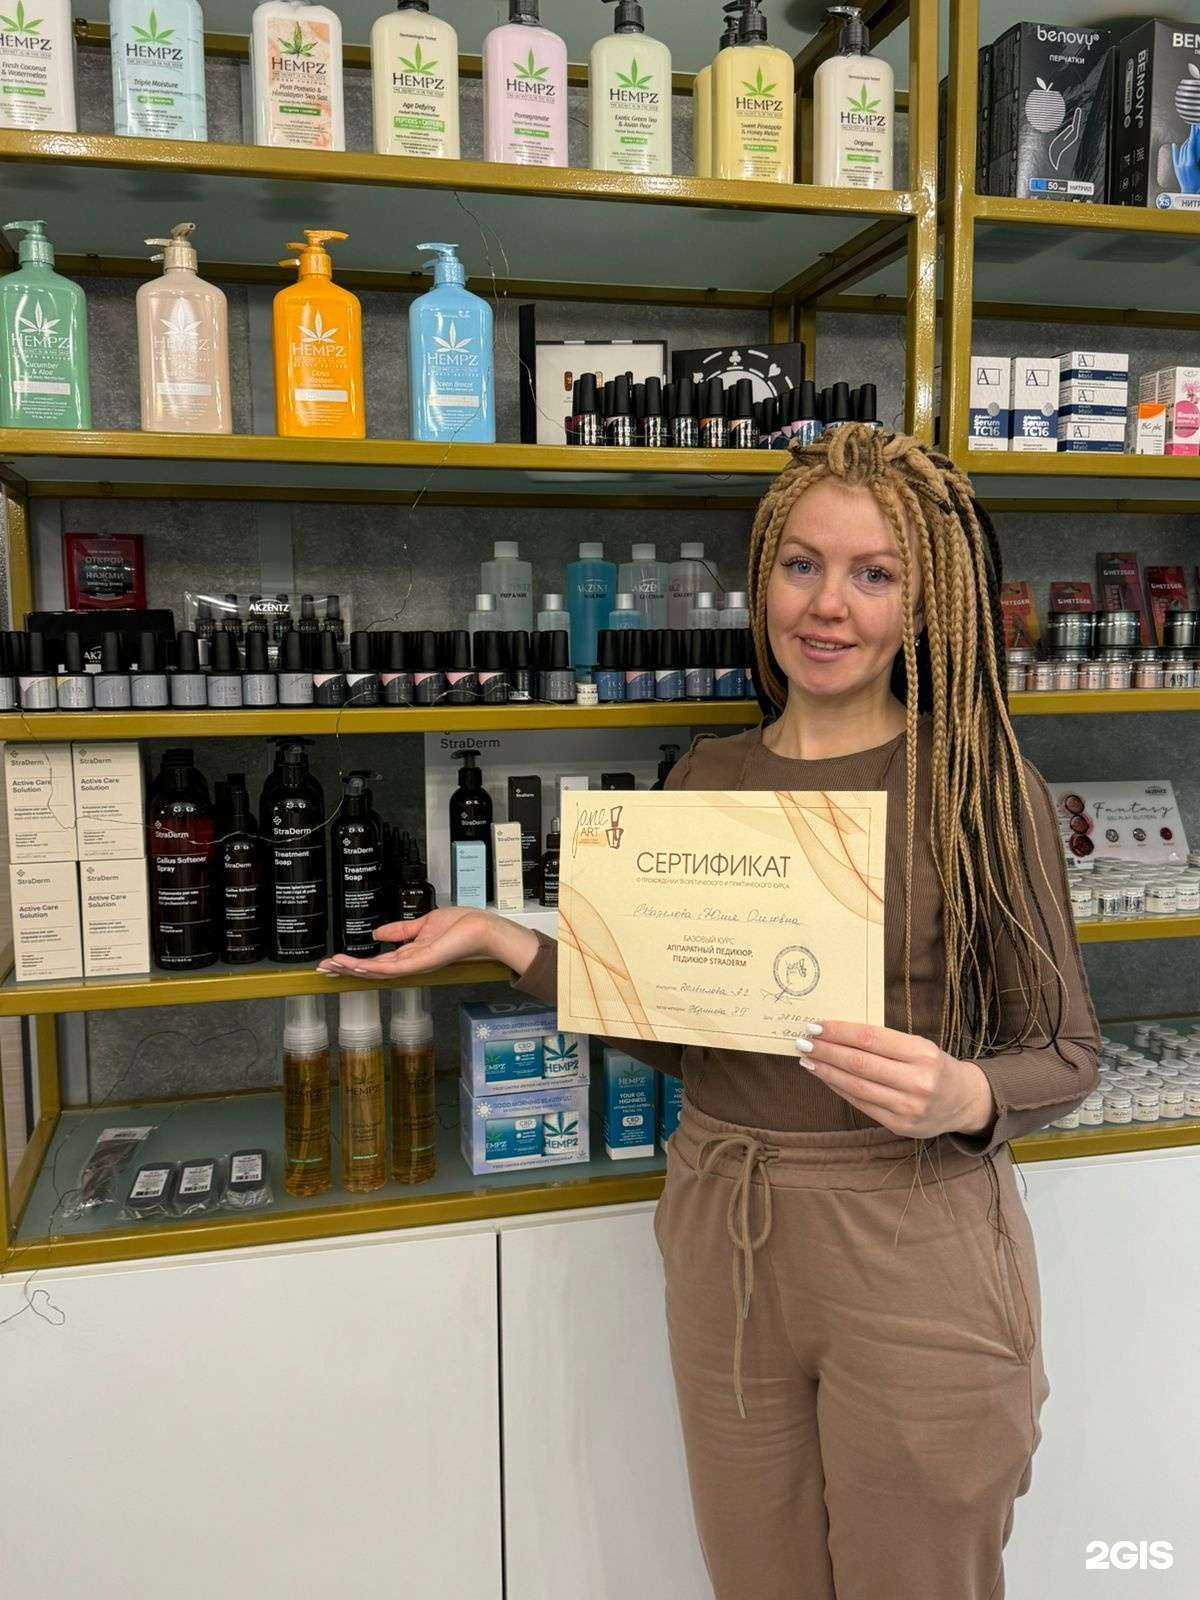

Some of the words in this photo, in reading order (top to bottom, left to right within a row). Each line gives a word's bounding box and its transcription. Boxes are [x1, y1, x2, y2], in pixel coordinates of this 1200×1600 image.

[126, 43, 183, 61] HEMPZ
[20, 64, 47, 72] Coconut
[271, 57, 327, 75] HEMPZ
[8, 69, 48, 79] Watermelon
[393, 73, 445, 90] HEMPZ
[506, 79, 556, 97] HEMPZ
[609, 88, 659, 104] HEMPZ
[402, 102, 414, 110] Age
[415, 103, 437, 112] Defying
[736, 97, 784, 112] HEMPZ
[840, 112, 886, 128] HEMPZ
[11, 333, 72, 349] HEMPZ
[292, 342, 346, 358] HEMPZ
[427, 352, 479, 366] HEMPZ
[974, 418, 1001, 427] Serum
[1023, 419, 1050, 428] Serum
[973, 426, 1001, 437] TC16
[1022, 426, 1050, 438] TC16
[441, 737, 500, 750] StraDerm
[11, 759, 45, 767] StraDerm
[80, 757, 112, 765] StraDerm
[13, 779, 34, 787] Active
[81, 778, 102, 786] Active
[13, 786, 42, 794] Solution
[1093, 802, 1174, 819] Fantasy
[155, 831, 190, 839] StraDerm
[274, 828, 312, 836] StraDerm
[580, 827, 599, 837] ART
[275, 850, 310, 858] Treatment
[344, 847, 374, 855] StraDerm
[177, 856, 207, 864] Softener
[636, 851, 791, 878] СЕРТИФИКАТ
[157, 865, 176, 873] Spray
[87, 874, 120, 882] StraDerm
[19, 904, 41, 912] Active
[42, 903, 59, 911] Care
[88, 901, 117, 909] Solution
[19, 912, 49, 920] Solution
[683, 935, 715, 943] БАЗОВЫЙ
[716, 936, 736, 945] КУРС
[667, 944, 715, 954] АППАРАТНЫЙ
[716, 947, 754, 958] ПЕДИКЮР,
[672, 955, 709, 964] ПЕДИКЮР
[710, 957, 747, 967] STRADERM
[545, 1060, 579, 1073] HEMPZ
[544, 1138, 579, 1150] HEMPZ
